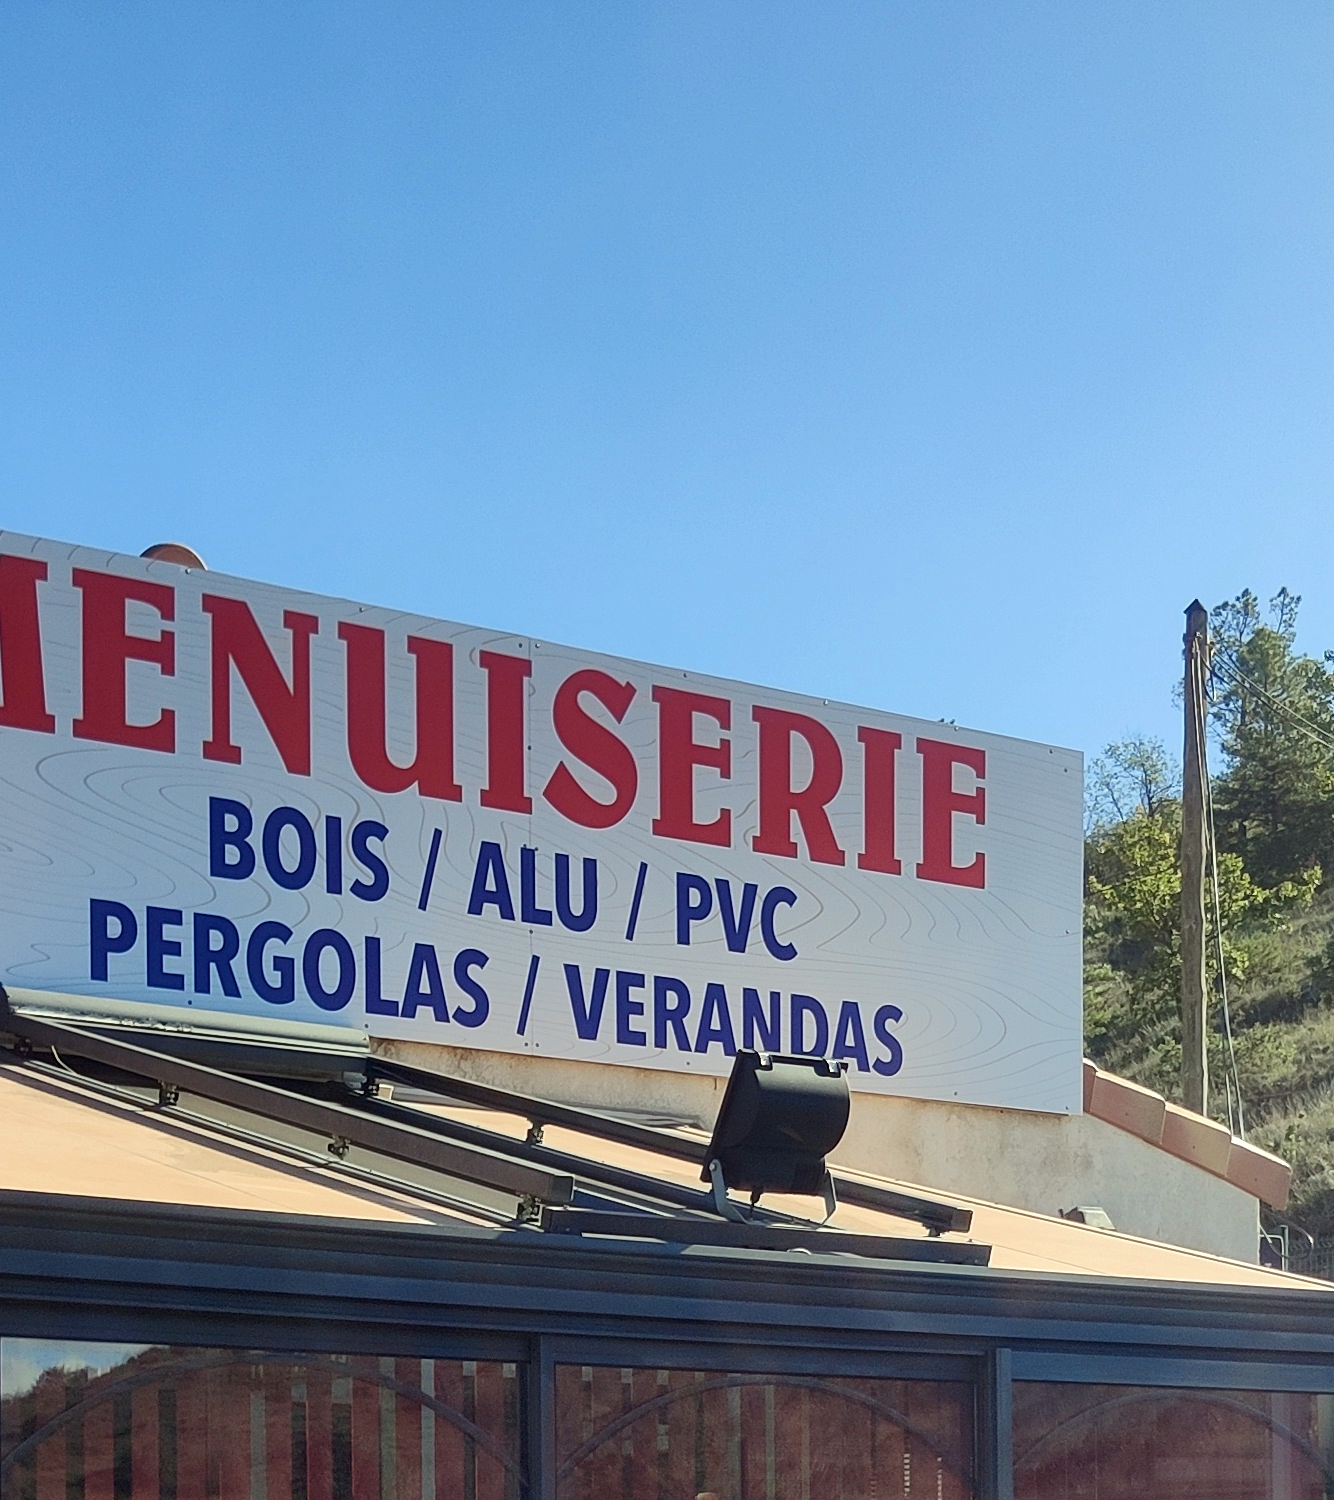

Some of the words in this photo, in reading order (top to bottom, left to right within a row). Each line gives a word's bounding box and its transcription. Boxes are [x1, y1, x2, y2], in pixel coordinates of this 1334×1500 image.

[207, 795, 391, 903] BOIS
[417, 827, 444, 912] /
[466, 840, 599, 934] ALU
[624, 861, 649, 943] /
[675, 870, 799, 963] PVC
[87, 896, 491, 1029] PERGOLAS
[515, 953, 542, 1036] /
[562, 963, 904, 1078] VERANDAS
